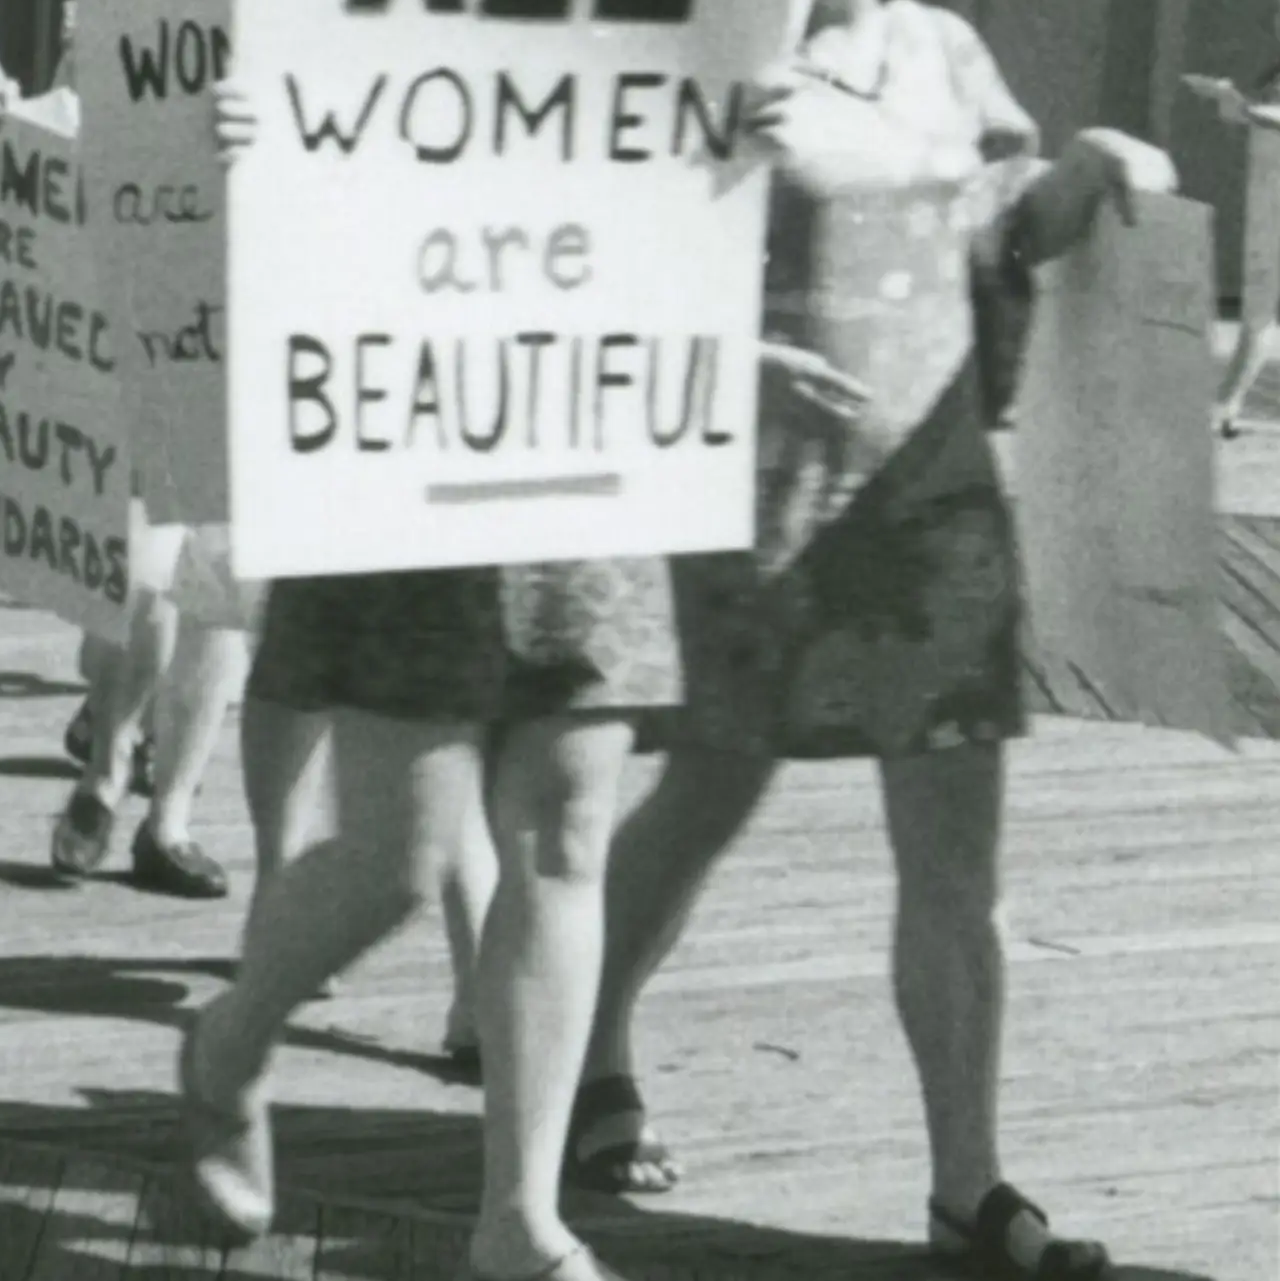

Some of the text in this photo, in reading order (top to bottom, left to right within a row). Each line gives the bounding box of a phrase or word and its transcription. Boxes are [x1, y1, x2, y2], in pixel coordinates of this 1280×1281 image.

[285, 65, 746, 164] WOMEN
[416, 221, 596, 293] are
[285, 332, 735, 454] BEAUTIFUL
